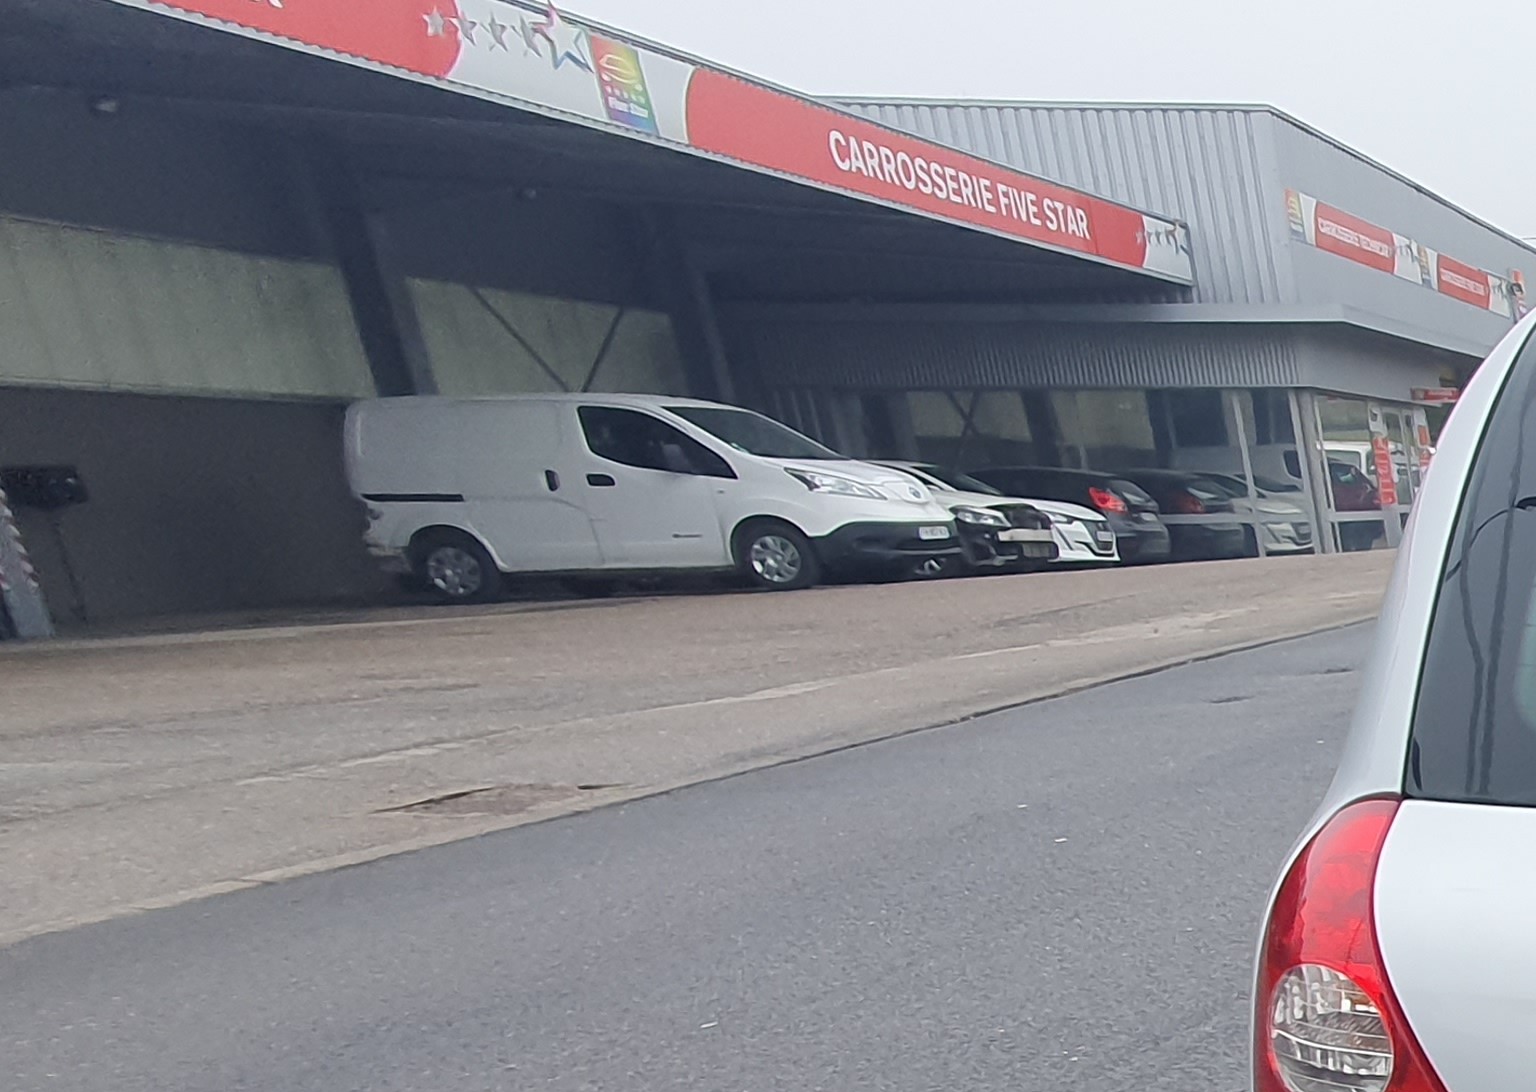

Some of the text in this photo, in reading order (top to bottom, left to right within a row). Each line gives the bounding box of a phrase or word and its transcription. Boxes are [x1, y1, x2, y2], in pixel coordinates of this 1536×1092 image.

[828, 130, 1091, 240] CARROSSERIE FIVE STAR
